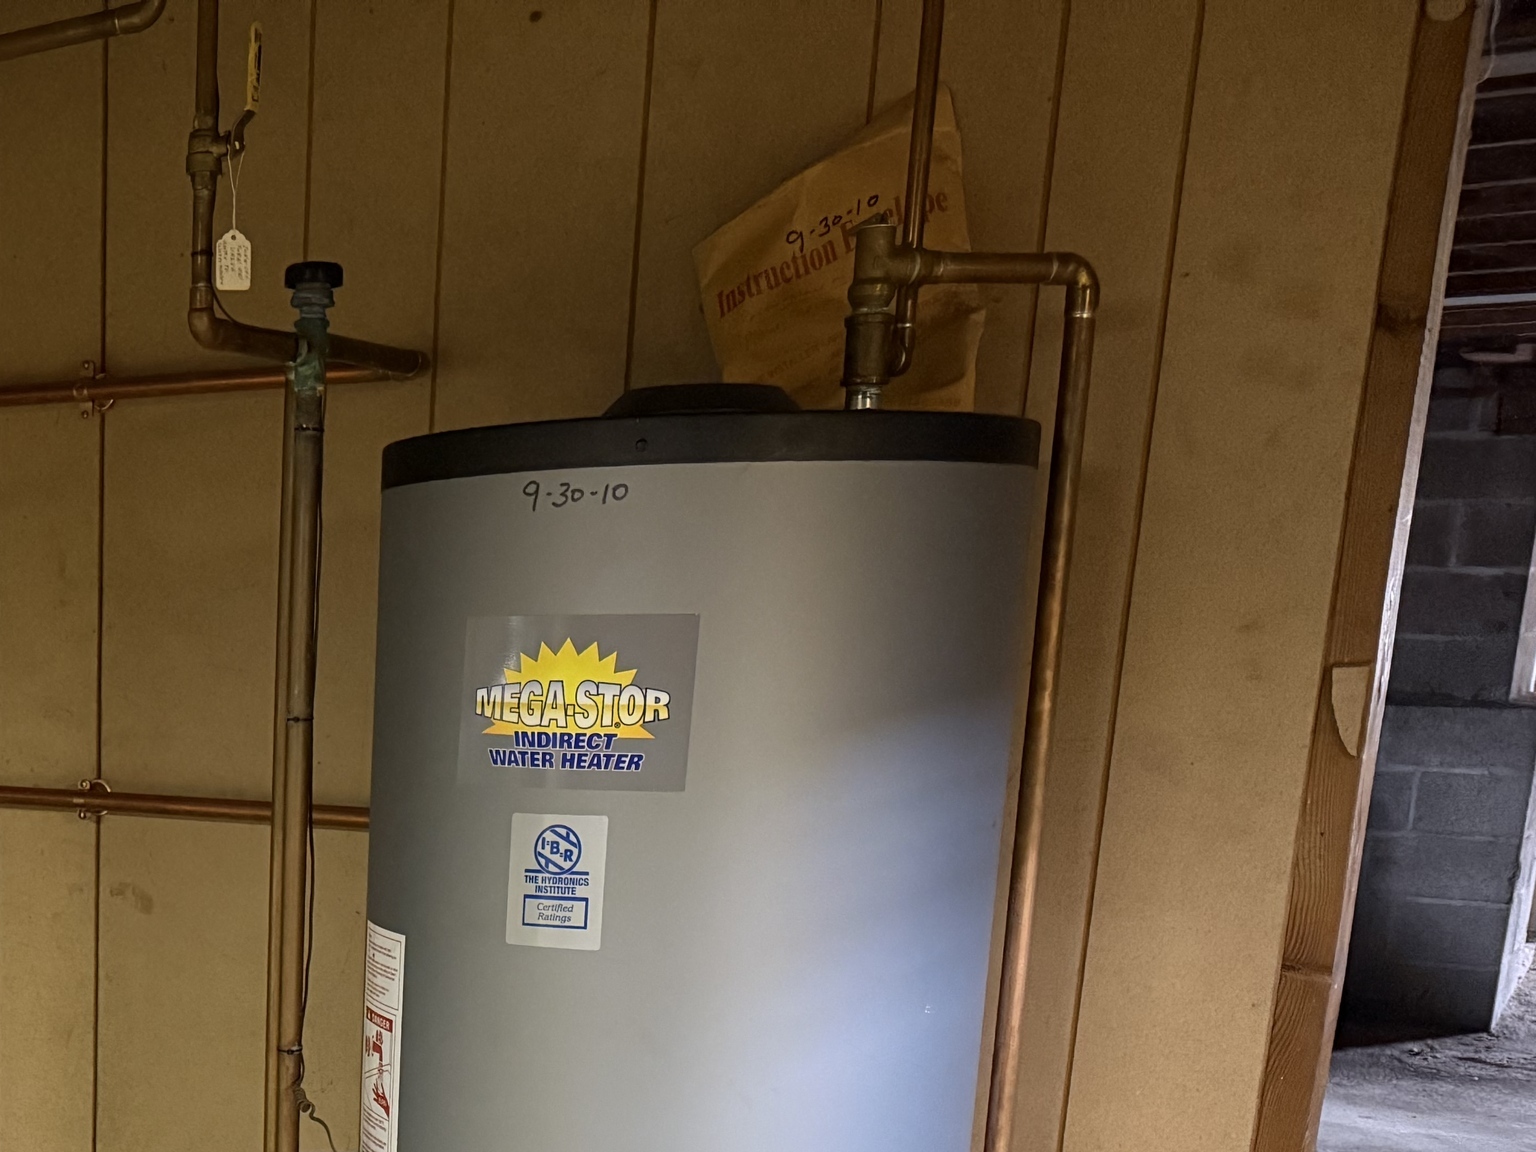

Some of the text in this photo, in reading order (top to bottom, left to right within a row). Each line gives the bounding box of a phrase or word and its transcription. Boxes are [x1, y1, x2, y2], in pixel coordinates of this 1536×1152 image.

[716, 242, 839, 319] Instruction
[522, 480, 629, 512] 9-30-10
[474, 680, 671, 729] MEGA-STOR
[513, 731, 618, 751] INDIRECT
[488, 748, 645, 772] WATER HEATER
[524, 874, 590, 887] THE HYDRONICS
[534, 885, 577, 896] INSTITUTE
[536, 902, 574, 913] Certified
[537, 912, 572, 923] Ratings
